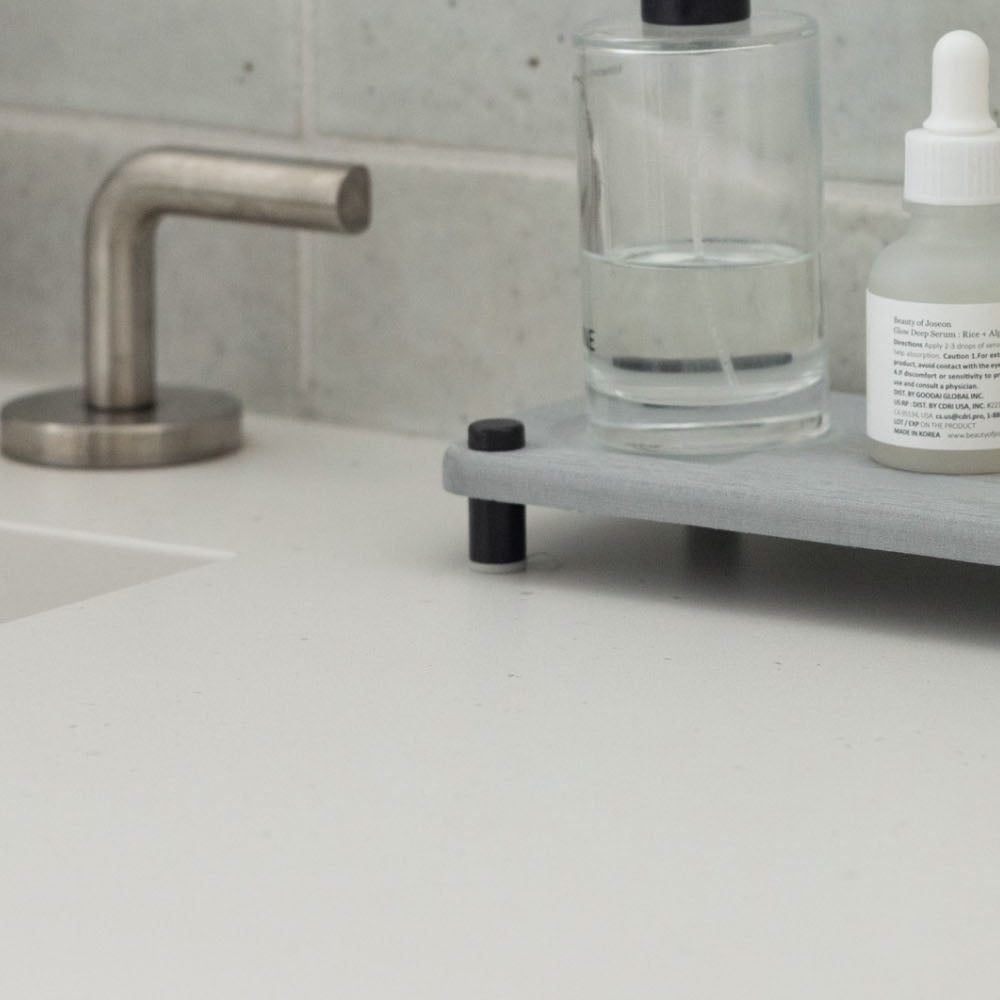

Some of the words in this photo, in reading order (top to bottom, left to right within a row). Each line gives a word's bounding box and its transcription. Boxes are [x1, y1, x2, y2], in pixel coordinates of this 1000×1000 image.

[894, 316, 915, 327] Beauty
[916, 319, 924, 327] of
[925, 320, 952, 328] Joseon
[911, 329, 929, 339] Deep
[962, 330, 980, 338] Rice
[894, 339, 922, 348] Directions
[924, 342, 942, 350] Apply
[904, 370, 936, 378] discomfort
[945, 383, 978, 391] physician.
[913, 401, 927, 409] DIST.
[931, 421, 943, 429] THE
[944, 422, 975, 430] PRODUCT
[894, 427, 910, 436] MADE
[919, 430, 941, 438] KOREA
